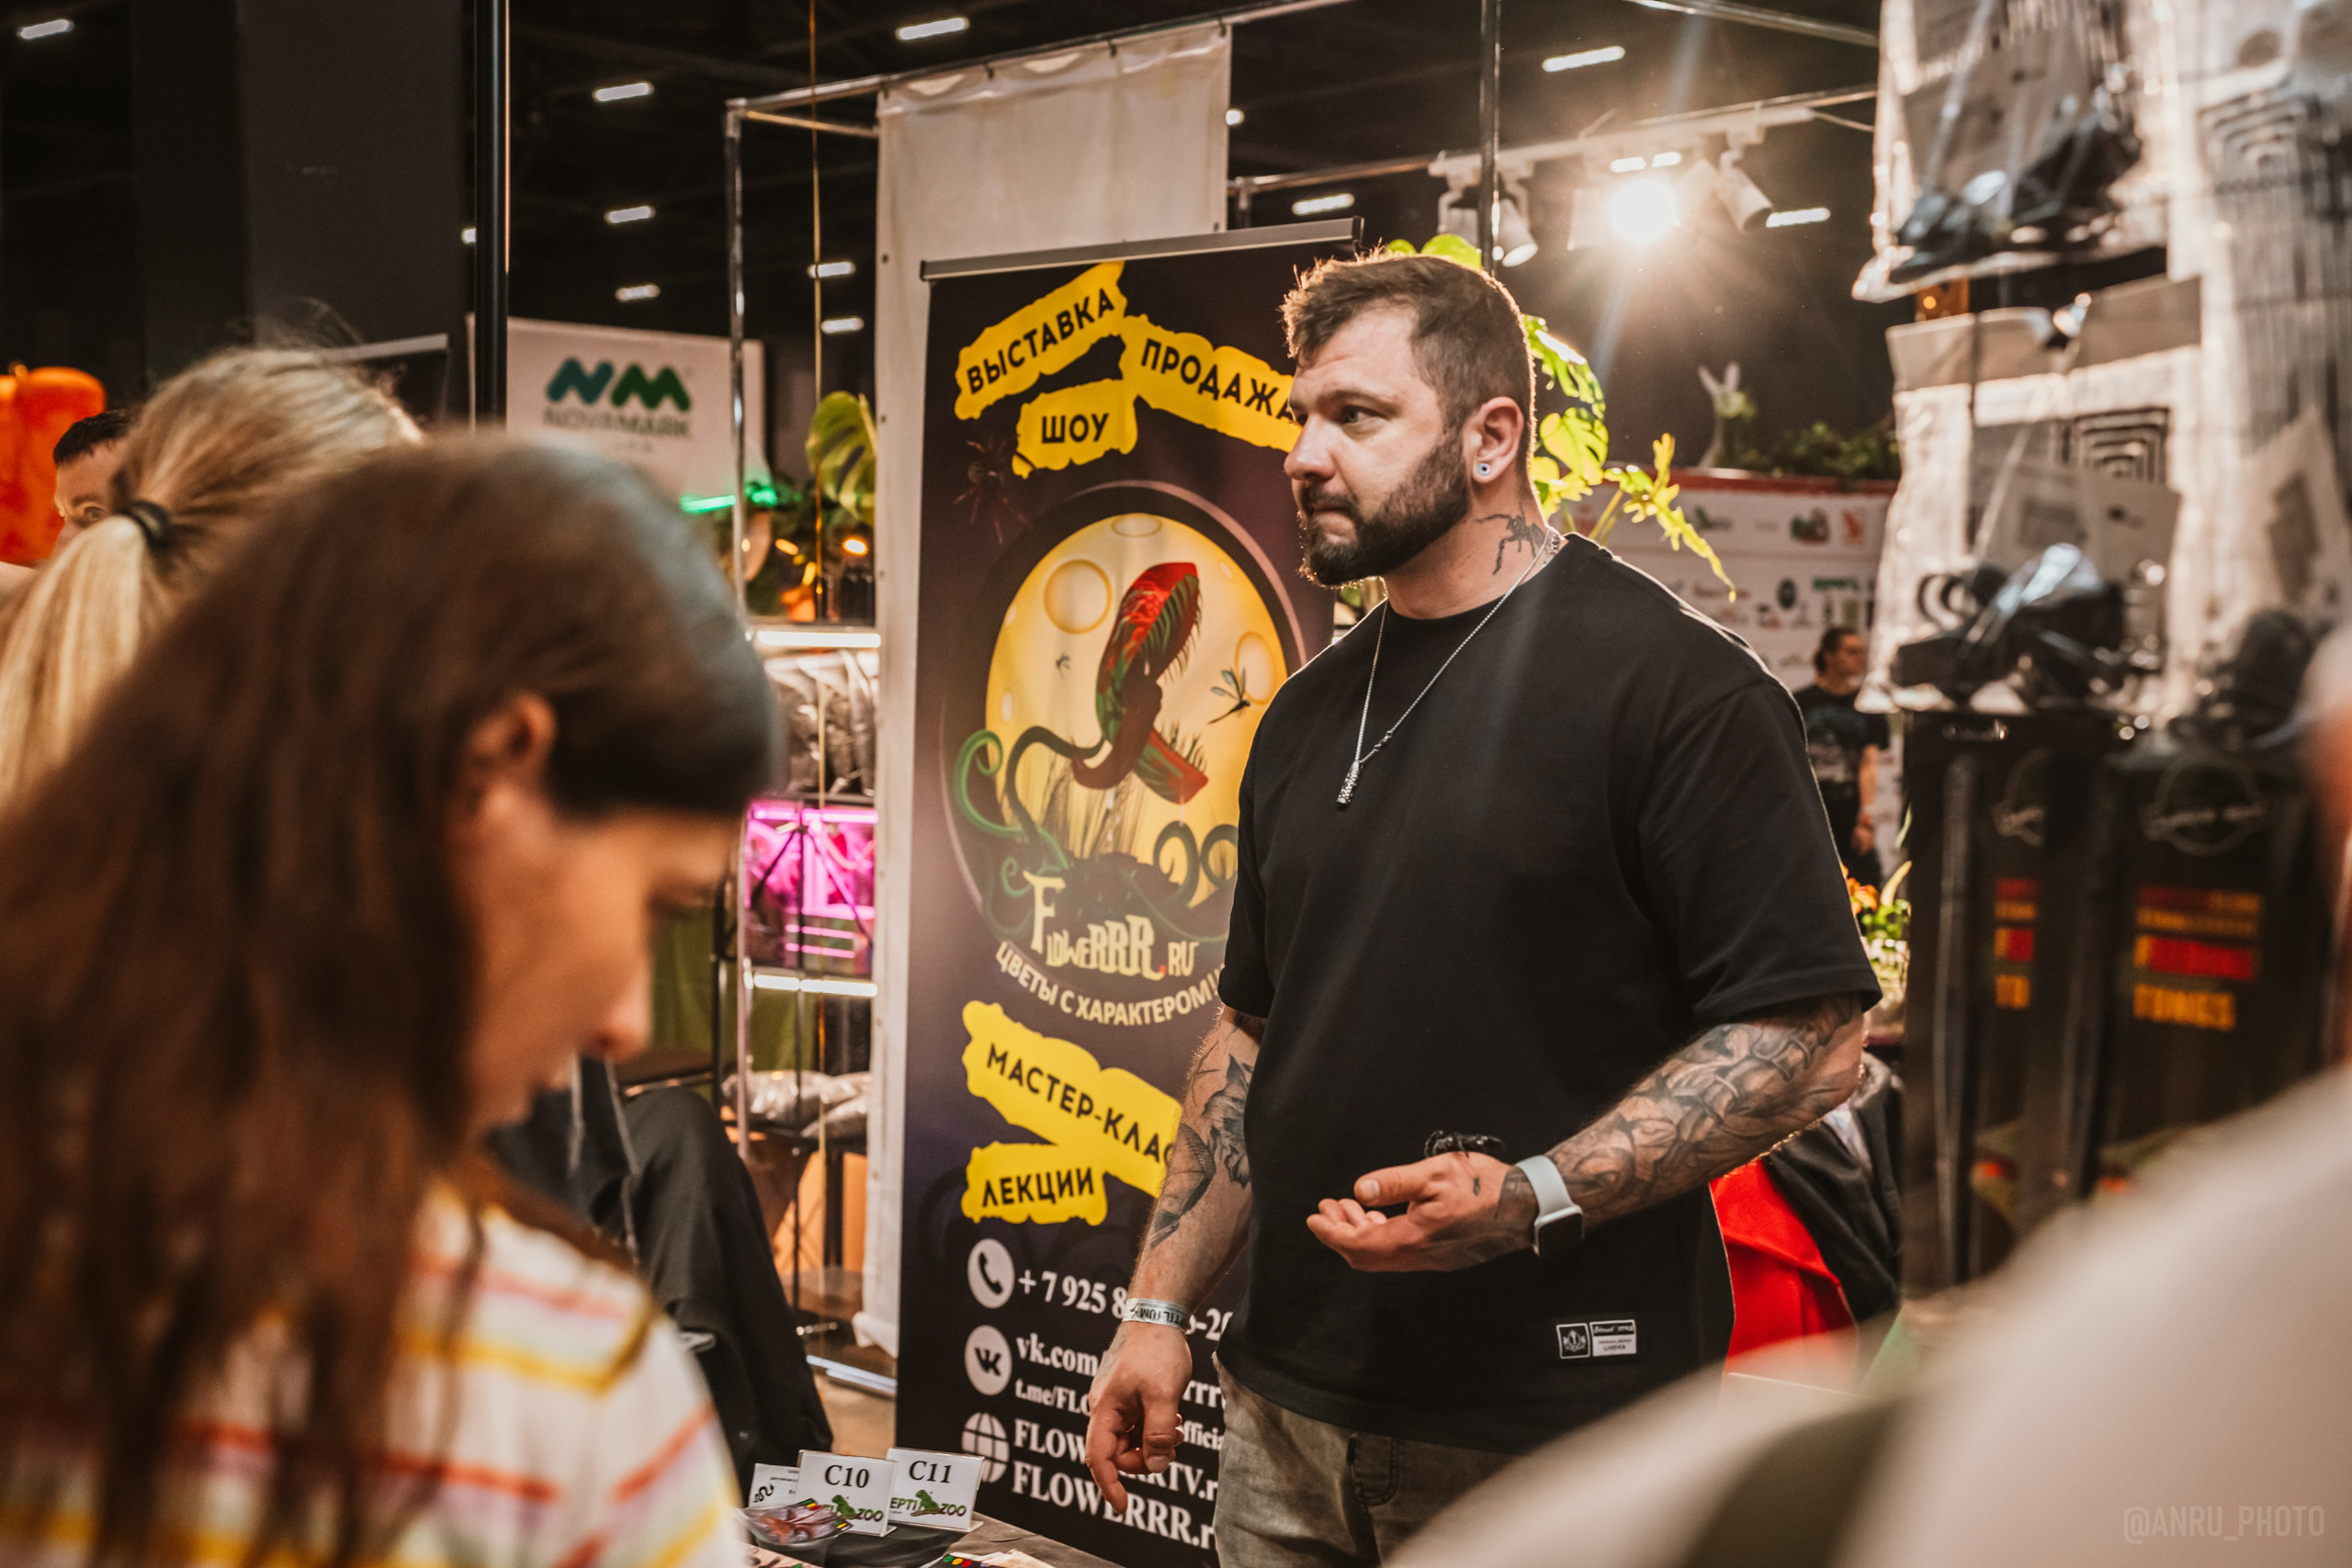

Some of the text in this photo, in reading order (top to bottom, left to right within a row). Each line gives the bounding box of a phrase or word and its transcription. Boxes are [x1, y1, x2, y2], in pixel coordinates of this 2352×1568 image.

[967, 288, 1115, 395] ВЫСТАВКА
[1041, 412, 1109, 445] ШОУ
[995, 941, 1226, 1027] ЦВЕТЫ С ХАРАКТЕРОМ!
[982, 1168, 1094, 1207] ЛЕКЦИИ
[1062, 1275, 1107, 1314] 925
[824, 1464, 870, 1488] C10
[910, 1461, 952, 1483] C11
[855, 1507, 884, 1522] ZOO
[937, 1503, 967, 1517] ZOO
